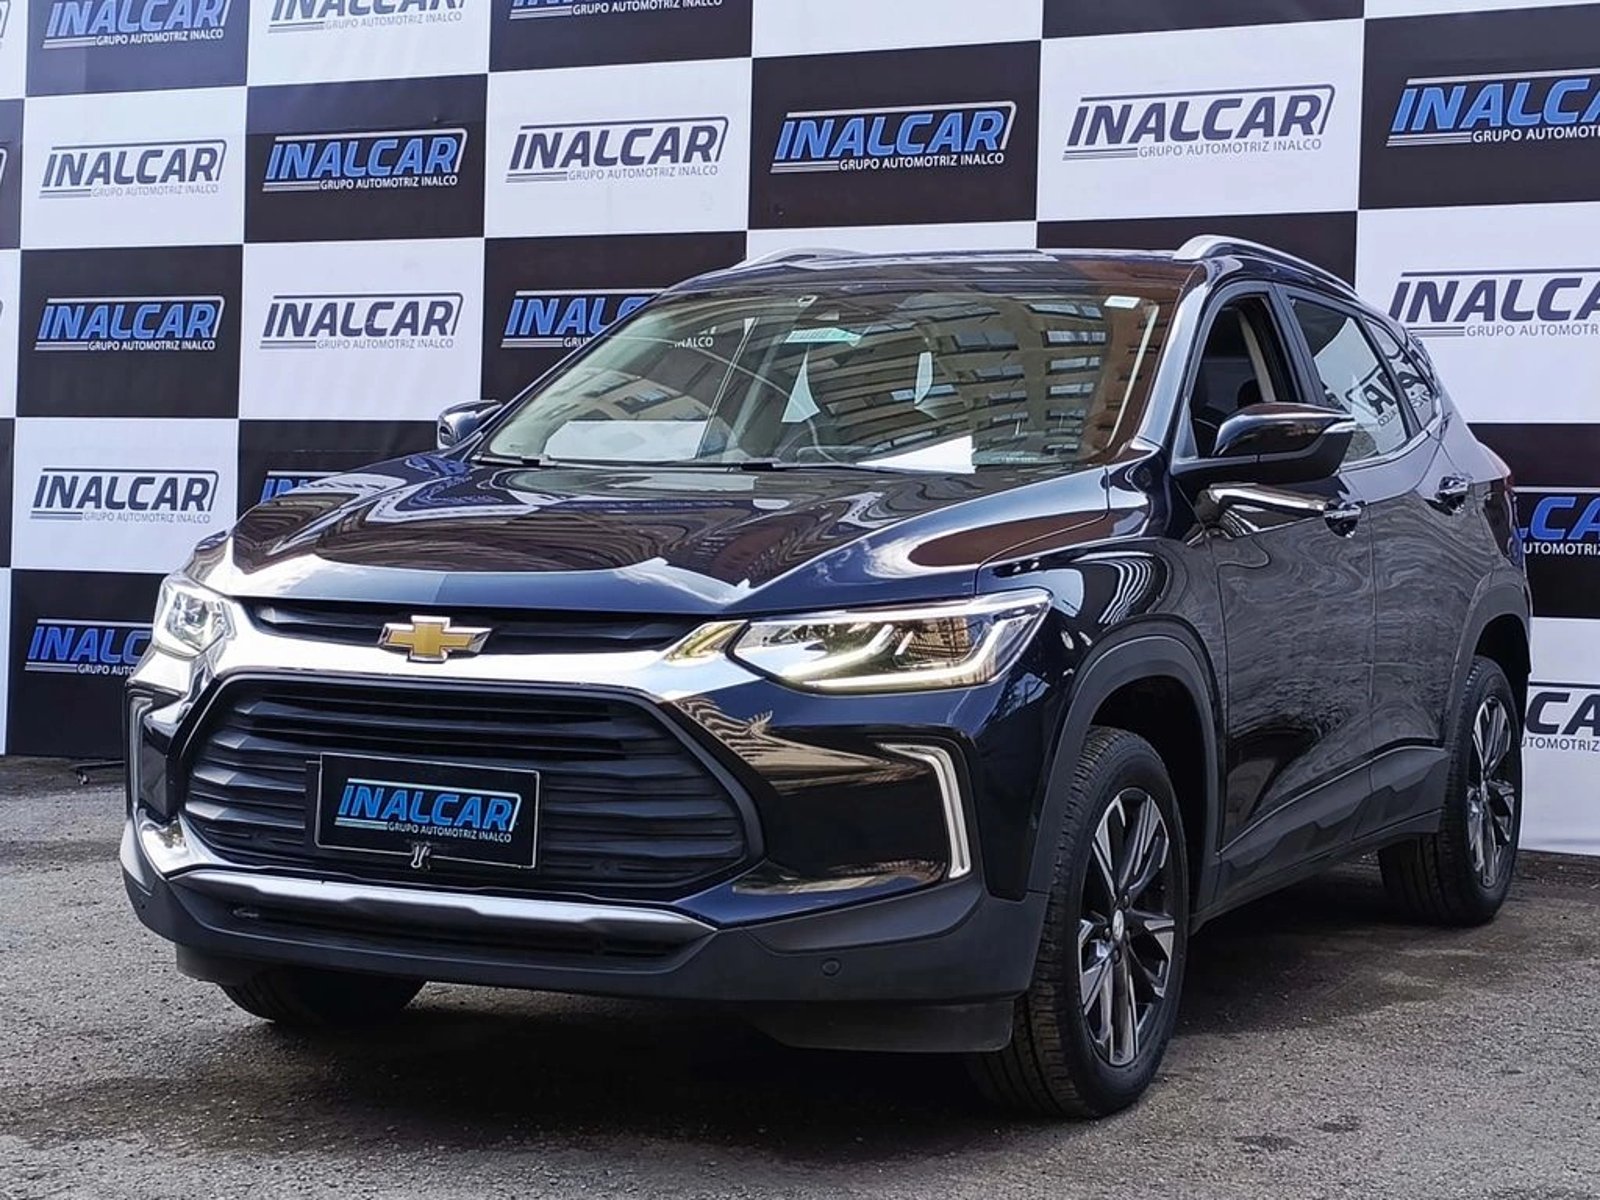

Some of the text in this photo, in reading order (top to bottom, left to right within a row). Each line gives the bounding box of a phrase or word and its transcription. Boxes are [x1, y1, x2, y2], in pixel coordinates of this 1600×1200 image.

[573, 4, 609, 15] GRUPO
[611, 0, 680, 13] AUTOMOTRIZ
[46, 0, 223, 37] INALCAR
[326, 11, 462, 30] GRUPO AUTOMOTRIZ INALCO
[96, 29, 224, 46] GRUPO AUTOMOTRIZ INALCO
[1067, 94, 1322, 147] INALCAR
[774, 110, 1004, 160] INALCAR
[1473, 125, 1600, 142] GRUPO AUTOMOT
[509, 125, 718, 171] INALCAR
[1139, 138, 1321, 158] GRUPO AUTOMOTRIZ INALCO
[42, 148, 218, 187] INALCAR
[265, 137, 457, 180] INALCAR
[840, 152, 1004, 171] GRUPO AUTOMOTRIZ INALCO
[320, 175, 458, 190] GRUPO AUTOMOTRIZ INALCO
[568, 165, 718, 181] GRUPO AUTOMOTRIZ INALCO
[91, 183, 219, 197] GRUPO AUTOMOTRIZ INALCO
[38, 303, 216, 340] INALCAR
[262, 301, 454, 337] INALCAR
[1466, 324, 1515, 336] GRUPO
[88, 340, 216, 351] GRUPO AUTOMOTRIZ INALCO
[317, 338, 454, 349] GRUPO AUTOMOTRIZ INALCO
[33, 475, 210, 512] INALCAR
[77, 663, 110, 675] GRUPO
[337, 785, 512, 831] INALCAR
[387, 822, 512, 843] GRUPO AUTOMOTRIZ INALCO
